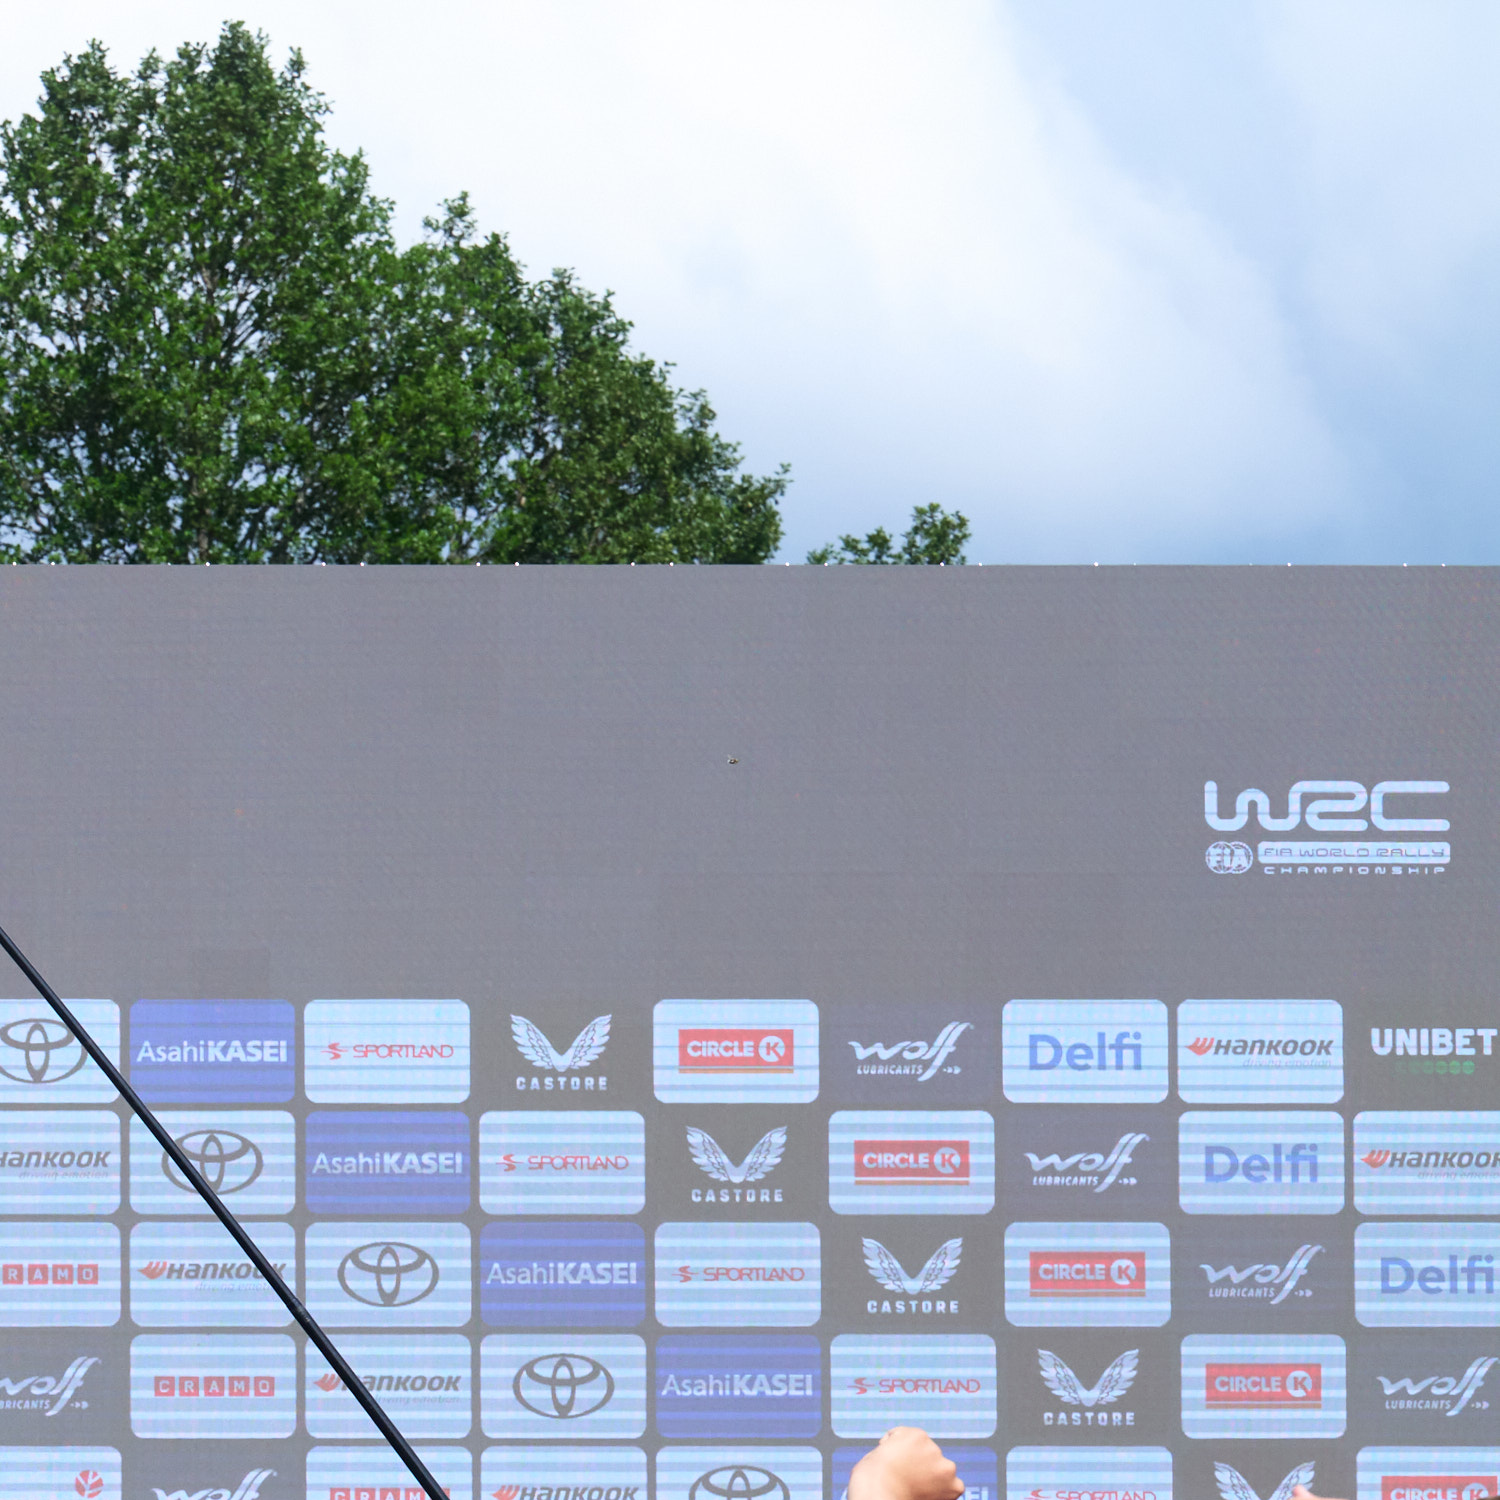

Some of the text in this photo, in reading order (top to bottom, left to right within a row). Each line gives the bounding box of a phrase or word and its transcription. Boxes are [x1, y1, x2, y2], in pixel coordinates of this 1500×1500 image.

[1263, 848, 1445, 858] FIA WORLD RALLY
[1263, 866, 1446, 875] CHAMPIONSHIP
[1371, 1025, 1499, 1053] UNIBET
[135, 1039, 286, 1063] AsahiKASEI
[351, 1043, 453, 1059] SPORTLAND
[688, 1041, 755, 1058] CIRCLE
[1028, 1031, 1142, 1071] Delfi
[858, 1065, 925, 1075] LUBRICANTS
[514, 1076, 607, 1091] CASTORE
[311, 1151, 462, 1175] AsahiKASEI
[527, 1155, 629, 1171] SPORTLAND
[863, 1153, 930, 1170] CIRCLE
[1204, 1142, 1318, 1182] Delfi
[1033, 1176, 1100, 1186] LUBRICANTS
[690, 1188, 783, 1203] CASTORE
[486, 1262, 637, 1286] AsahiKASEI
[702, 1266, 804, 1282] SPORTLAND
[1039, 1264, 1106, 1281] CIRCLE
[1380, 1254, 1494, 1294] Delfi
[1209, 1288, 1276, 1298] LUBRICANTS
[865, 1299, 958, 1314] CASTORE
[155, 1377, 273, 1394] CRAMO
[662, 1374, 813, 1398] AsahiKASEI
[878, 1378, 980, 1394] SPORTLAND
[1215, 1376, 1282, 1393] CIRCLE
[1386, 1400, 1453, 1410] LUBRICANTS
[1041, 1411, 1134, 1426] CASTORE
